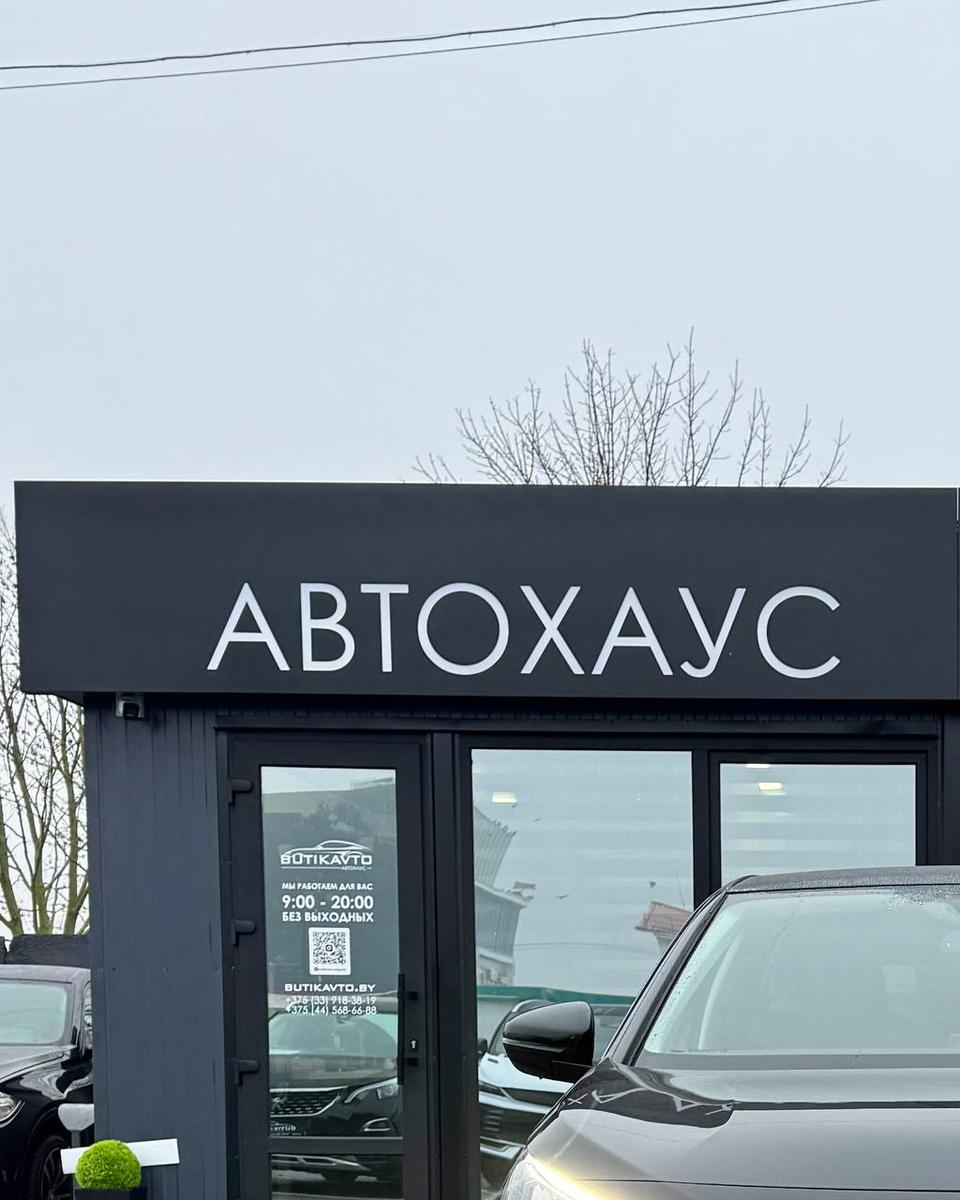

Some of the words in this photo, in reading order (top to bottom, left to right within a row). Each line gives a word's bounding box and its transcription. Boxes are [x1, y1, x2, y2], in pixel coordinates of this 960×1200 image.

[207, 582, 841, 678] АВТОХАУС
[280, 854, 372, 865] BUTIKAVTO
[297, 883, 338, 891] РАБОТАЕМ
[338, 883, 355, 891] ДЛЯ
[282, 895, 315, 909] 9:00
[331, 895, 374, 909] 20:00
[282, 911, 301, 922] БЕЗ
[304, 911, 374, 922] ВЫХОДНЫХ
[285, 984, 375, 992] BUTIKAVTO.BY
[285, 996, 308, 1005] +375
[310, 996, 328, 1006] (33)
[331, 996, 376, 1005] 918-38-19
[285, 1005, 308, 1015] +375
[311, 1005, 328, 1016] (44)
[331, 1006, 377, 1015] 568-66-88
